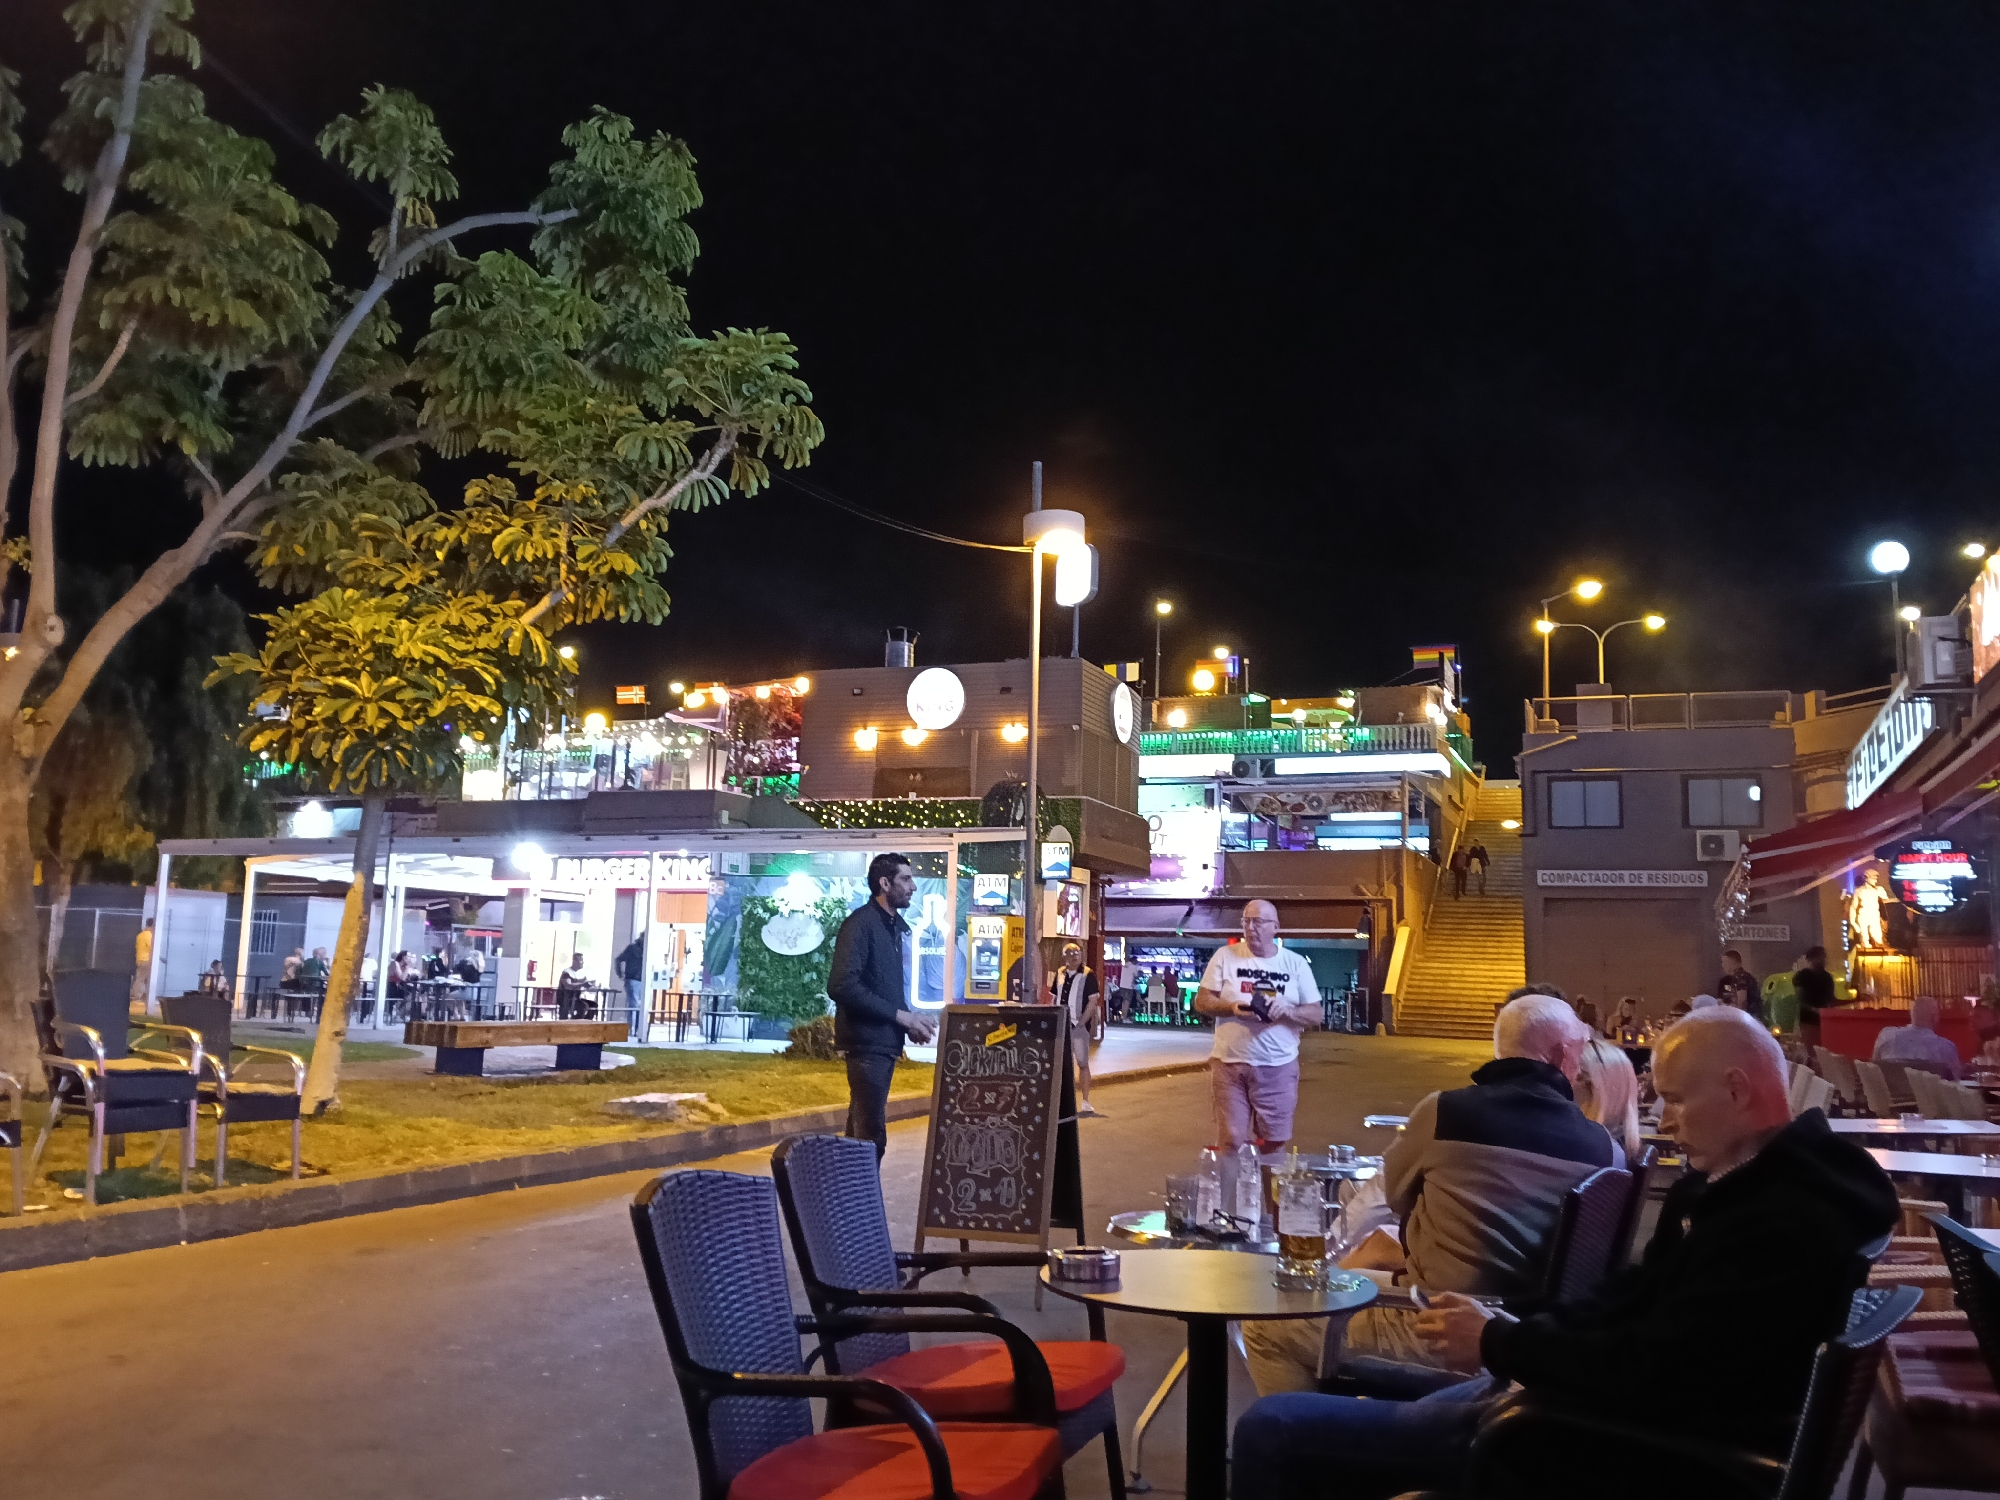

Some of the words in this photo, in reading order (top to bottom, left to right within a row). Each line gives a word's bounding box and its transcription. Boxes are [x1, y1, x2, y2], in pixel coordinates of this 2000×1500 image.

[1898, 853, 1933, 863] HAPPY
[1936, 853, 1969, 863] HOUR
[557, 858, 651, 880] BURGER
[978, 877, 1007, 888] ATM
[1541, 872, 1625, 884] COMPACTADOR
[1629, 873, 1643, 884] DE
[1648, 873, 1704, 884] RESIDUOS
[978, 924, 1003, 934] ATM
[1237, 967, 1290, 983] MOSCHINO
